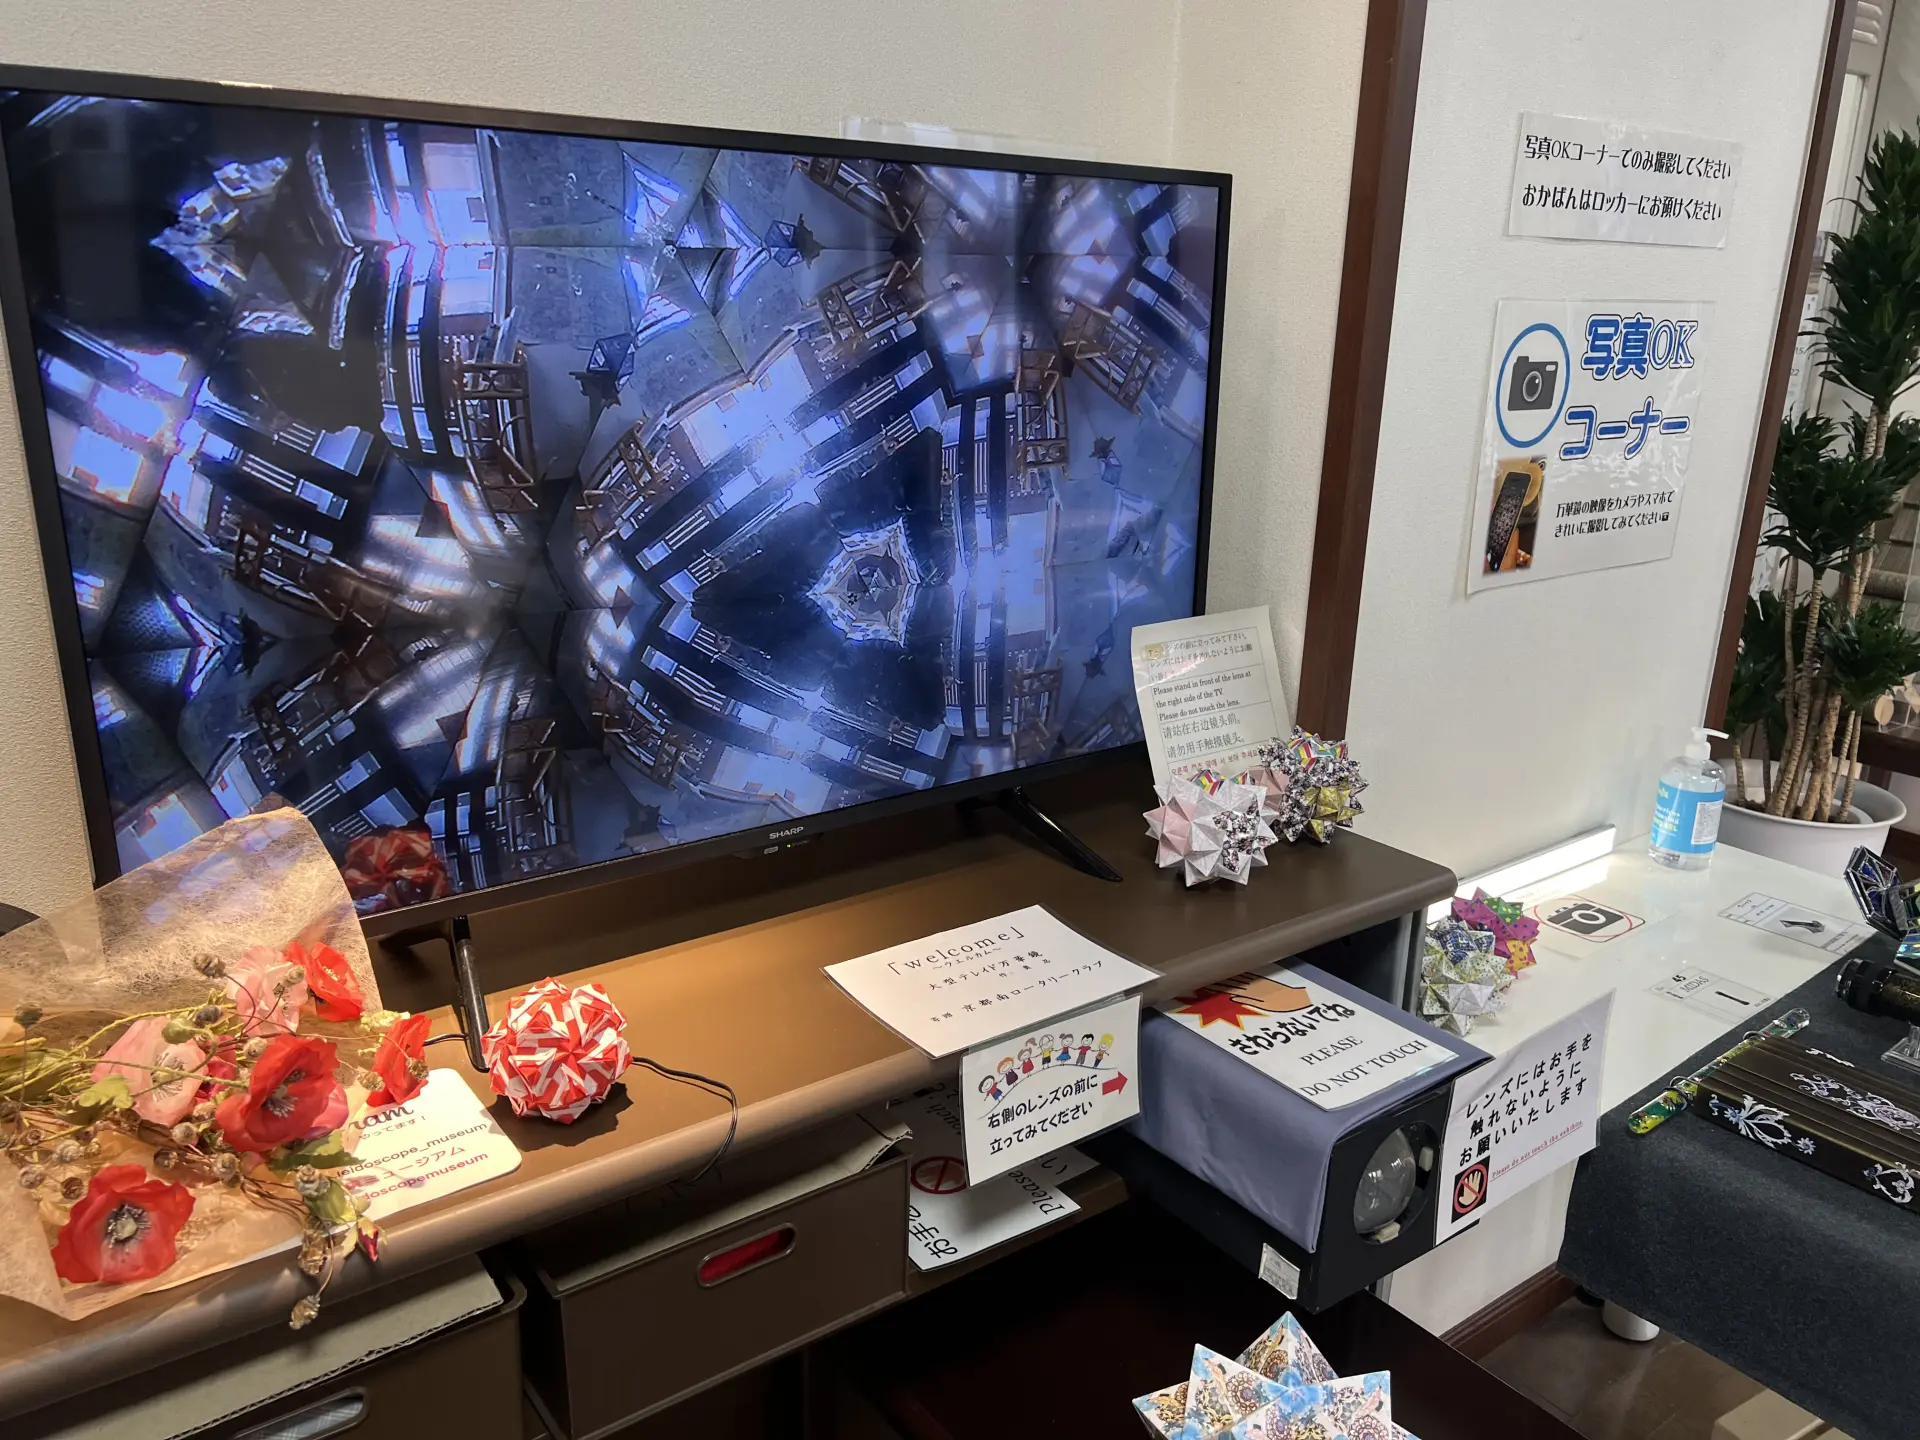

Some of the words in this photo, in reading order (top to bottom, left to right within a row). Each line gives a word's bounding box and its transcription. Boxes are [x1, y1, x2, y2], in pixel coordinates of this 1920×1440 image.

[1522, 183, 1722, 221] おかばんはロッカーにお預けください
[1581, 312, 1698, 381] 写真OK
[1559, 396, 1690, 461] コーナー
[1153, 685, 1173, 695] Please
[1174, 682, 1191, 692] stand
[1199, 678, 1214, 687] front
[1214, 675, 1221, 683] of
[1232, 672, 1245, 680] lens
[1167, 697, 1183, 707] right
[1184, 694, 1196, 702] side
[1196, 692, 1203, 700] of
[1159, 712, 1178, 722] Please
[1179, 709, 1187, 717] do
[1188, 707, 1198, 715] not
[1198, 704, 1216, 713] touch
[1162, 712, 1241, 739] 请站在右边镜头前。
[769, 826, 804, 840] SHARP
[1672, 974, 1687, 983] 45
[1679, 975, 1709, 993] MIDAS
[1227, 1002, 1356, 1055] さわらないでね
[1299, 1035, 1363, 1066] PLEASE
[1300, 1080, 1331, 1096] DO
[1334, 1064, 1367, 1087] NOT
[1365, 1039, 1428, 1069] TOUCH
[1466, 1033, 1593, 1118] レンズにはお手を
[987, 1073, 1098, 1129] 右側のレンズの前に
[1459, 1077, 1587, 1167] お願いいたします
[1469, 1060, 1582, 1139] 触れないように
[989, 1100, 1093, 1155] 立ってみてください
[1008, 1169, 1064, 1215] Please
